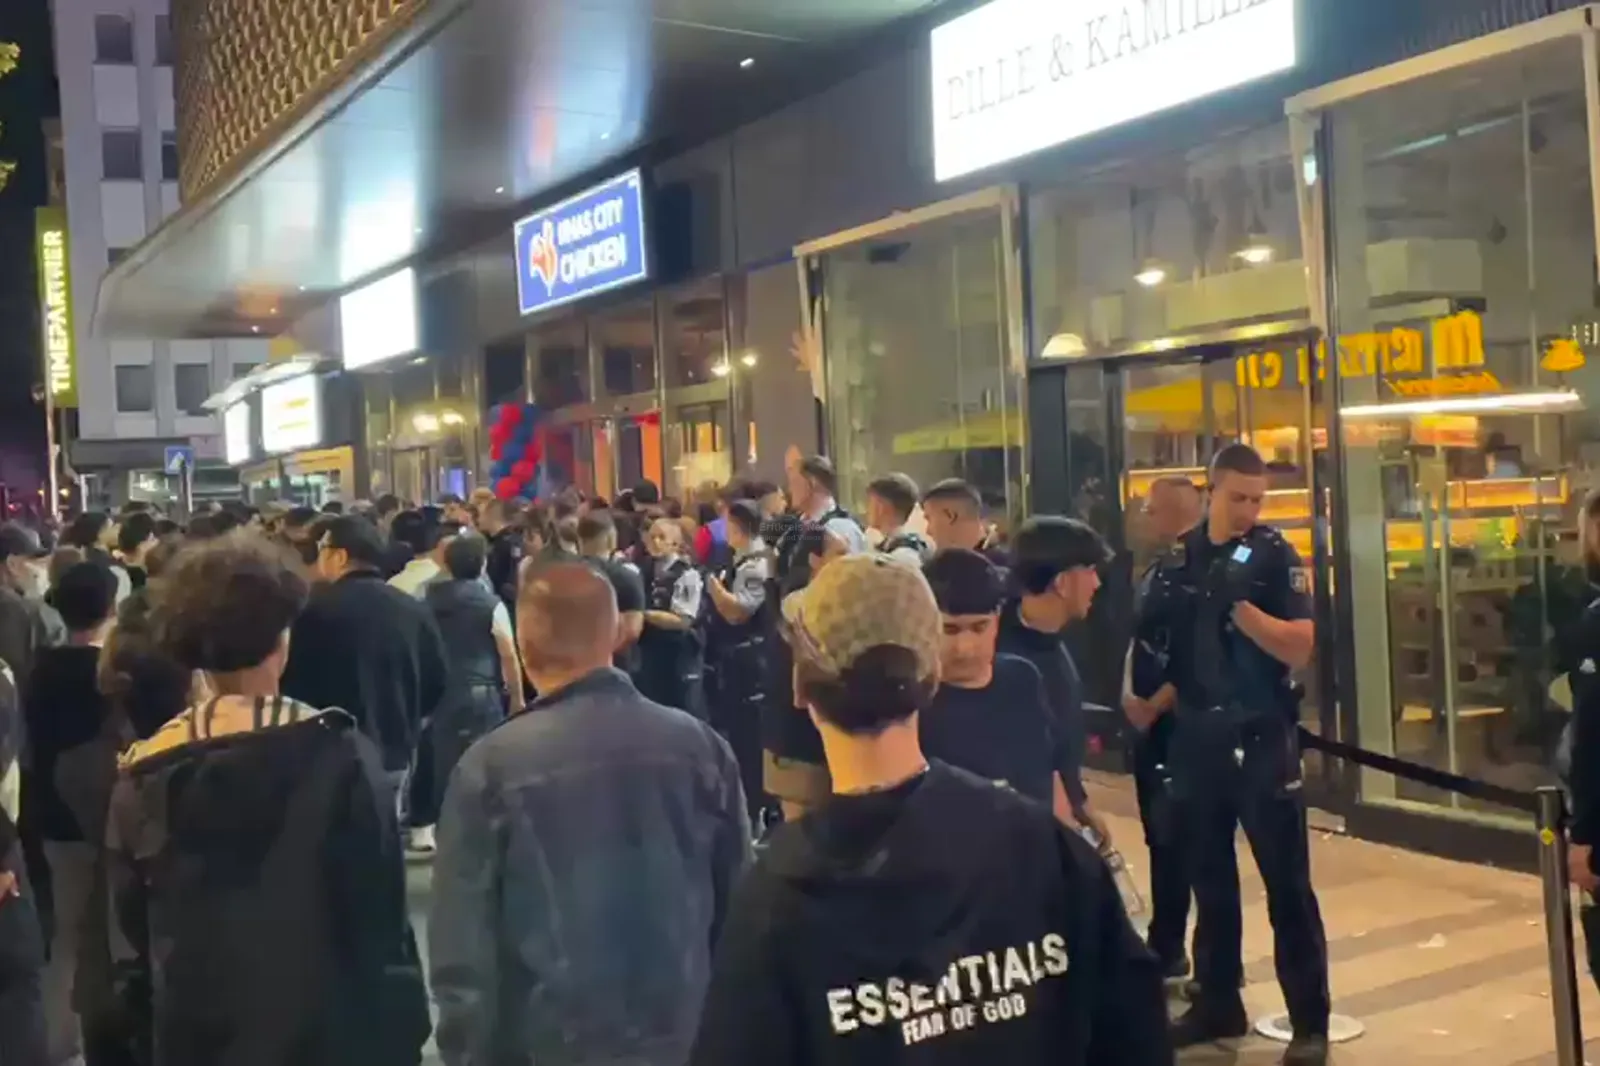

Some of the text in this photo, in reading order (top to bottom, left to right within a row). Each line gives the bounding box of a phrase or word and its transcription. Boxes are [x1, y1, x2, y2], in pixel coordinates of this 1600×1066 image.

[1048, 33, 1073, 83] &
[827, 932, 1069, 1035] ESSENTIALS
[902, 993, 1026, 1045] FEAR OF GOD
